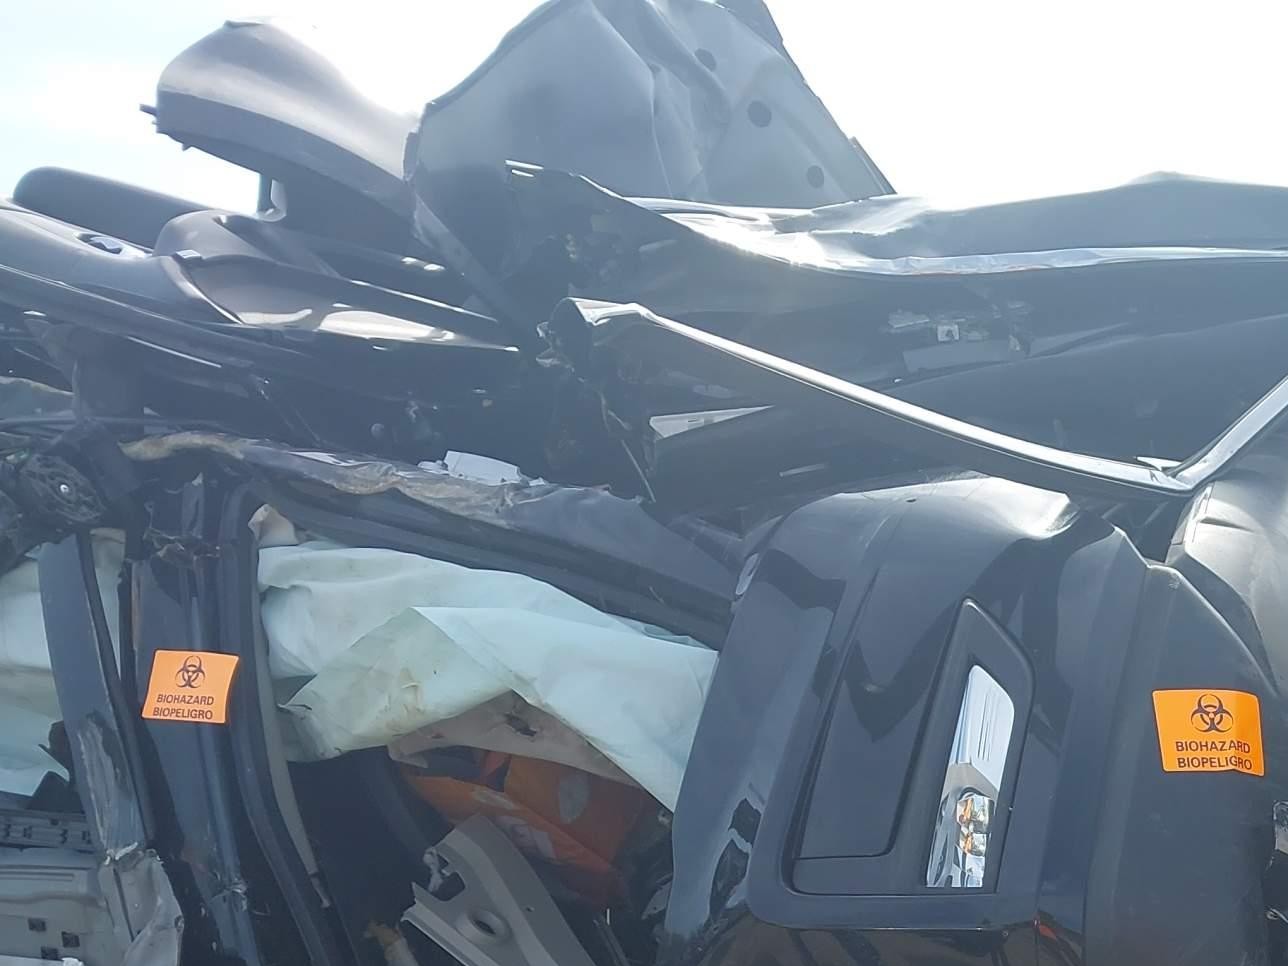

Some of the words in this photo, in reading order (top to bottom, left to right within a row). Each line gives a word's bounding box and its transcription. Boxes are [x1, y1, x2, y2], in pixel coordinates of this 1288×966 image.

[156, 694, 214, 705] BIOHAZARD
[153, 707, 213, 719] BIOPELIGRO
[1175, 740, 1251, 753] BIOHAZARD
[1177, 756, 1252, 770] BIOPELIGRO
